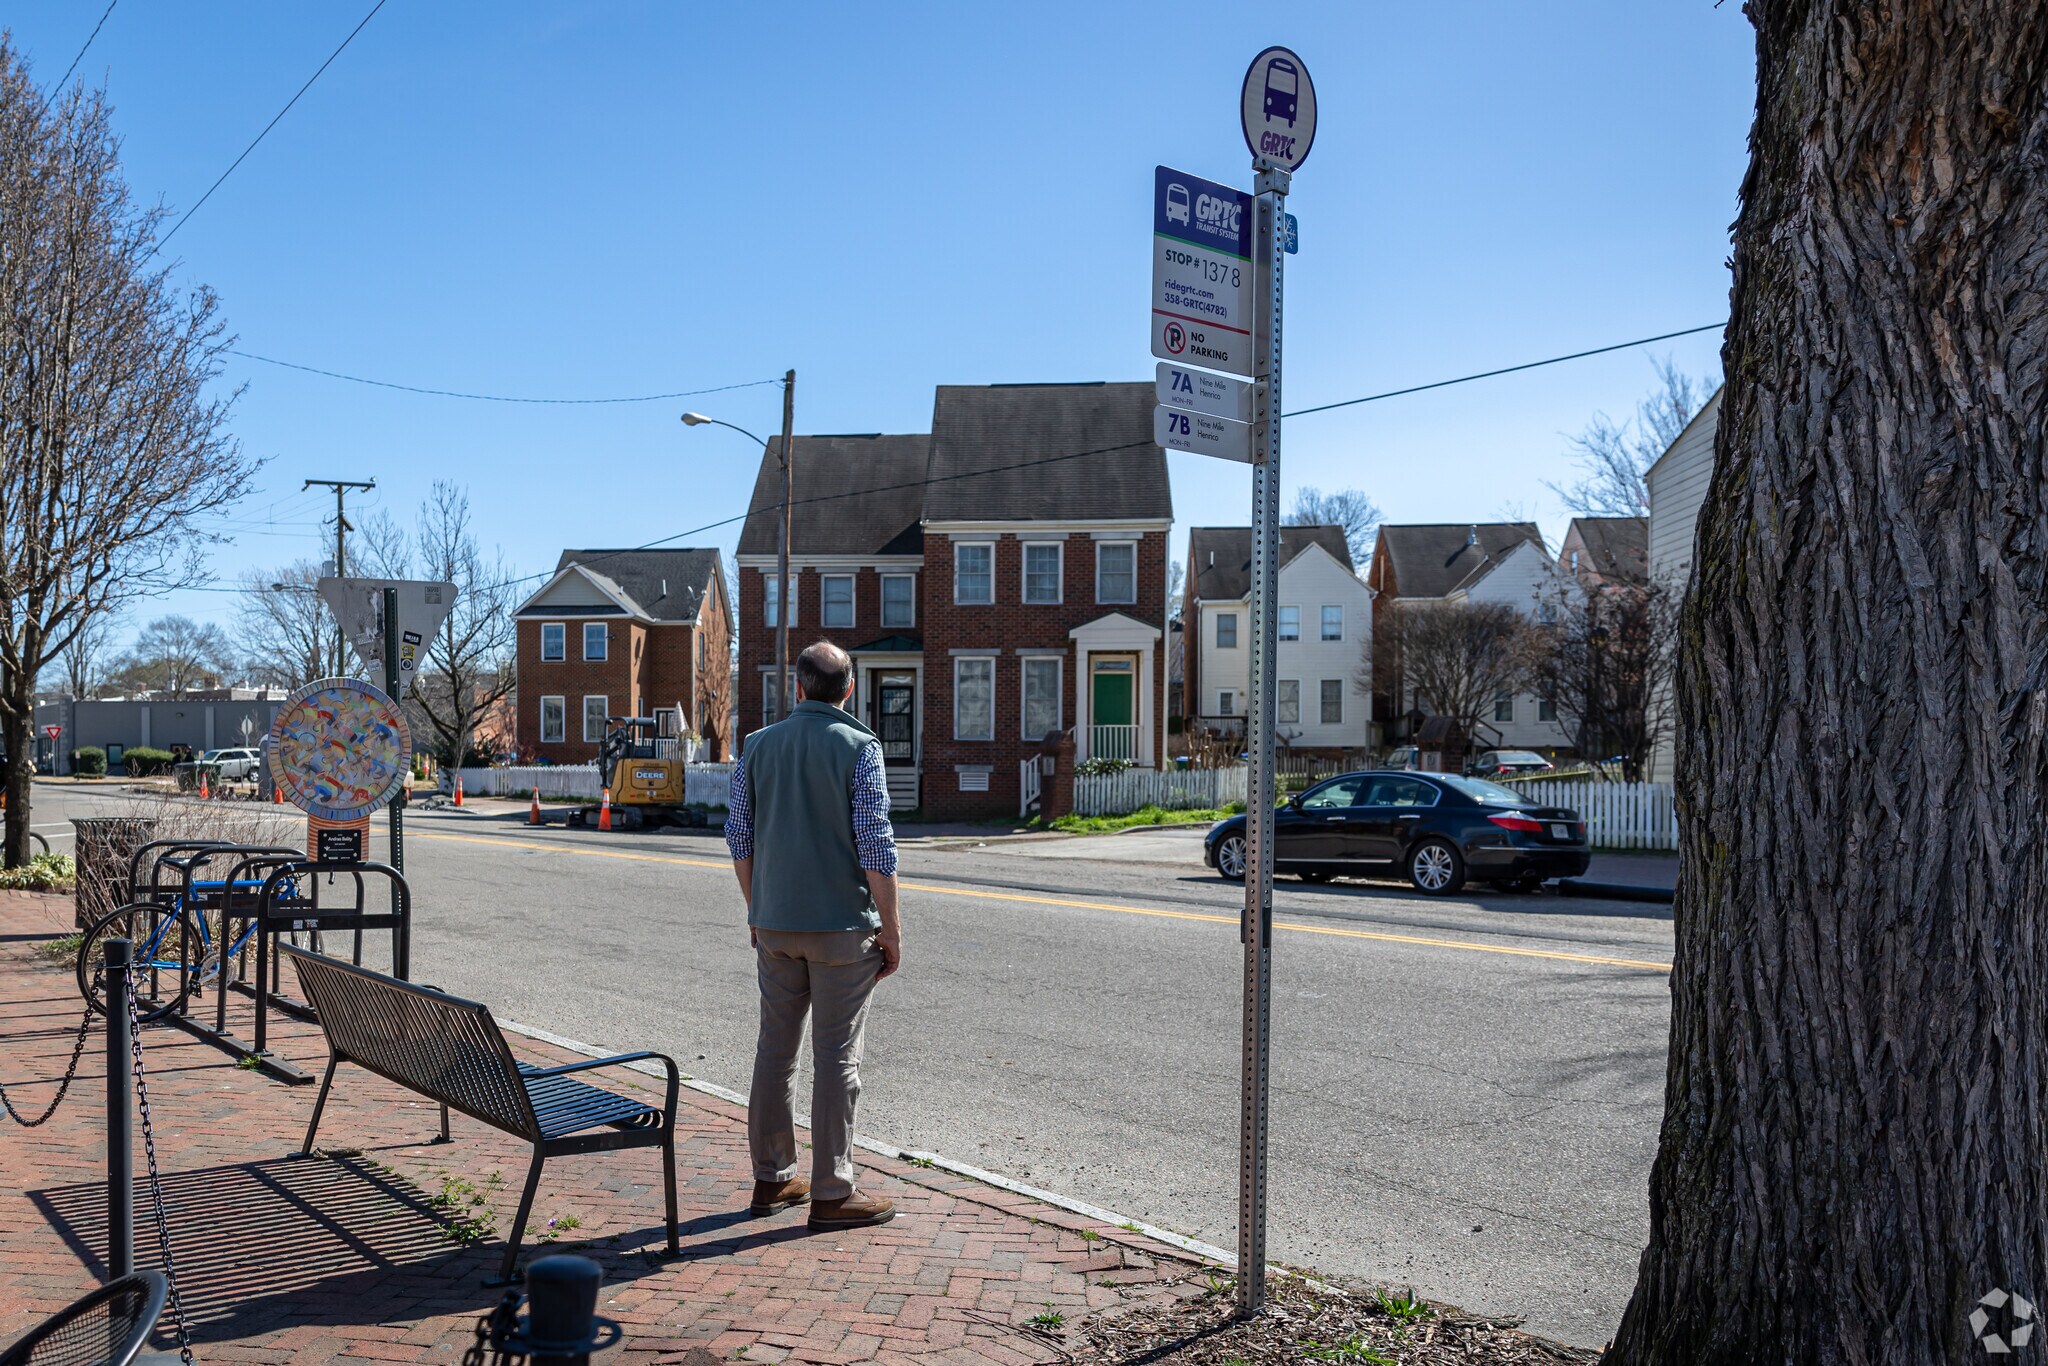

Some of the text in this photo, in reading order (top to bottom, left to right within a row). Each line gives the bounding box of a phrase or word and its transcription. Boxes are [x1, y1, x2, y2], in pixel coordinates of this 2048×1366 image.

[1260, 130, 1296, 160] GRTC
[1195, 193, 1242, 233] GRTC
[1195, 221, 1240, 242] TRANSIT SYSTEM
[1164, 279, 1215, 300] ridegrtc.com
[1164, 292, 1228, 319] 358-GRTC(4782)
[1190, 331, 1205, 343] NO
[1190, 344, 1229, 362] PARKING
[1171, 370, 1227, 395] 7A Nine Mile
[1199, 387, 1222, 400] Henrico
[1168, 412, 1225, 436] 7B Nine Mile
[1197, 430, 1219, 442] Henrico
[636, 771, 665, 779] DEERE
